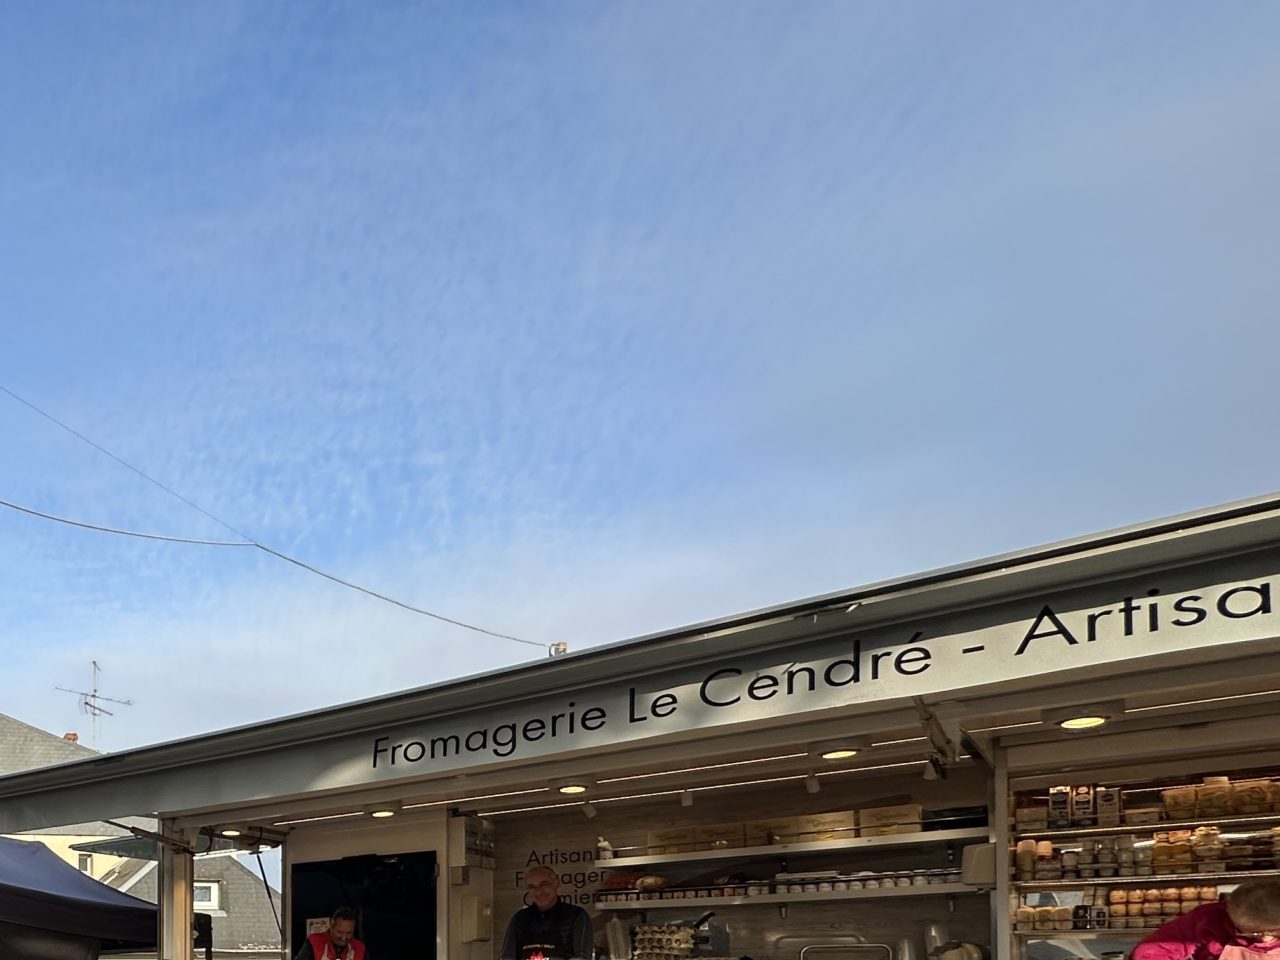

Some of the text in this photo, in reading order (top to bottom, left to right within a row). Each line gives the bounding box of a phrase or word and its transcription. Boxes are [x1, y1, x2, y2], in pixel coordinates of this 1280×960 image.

[372, 702, 607, 768] Fromagerie
[629, 687, 678, 723] Le
[699, 631, 932, 707] Cendré
[1014, 588, 1272, 656] Artisa
[526, 849, 593, 867] Artisan
[515, 870, 608, 889] Fager
